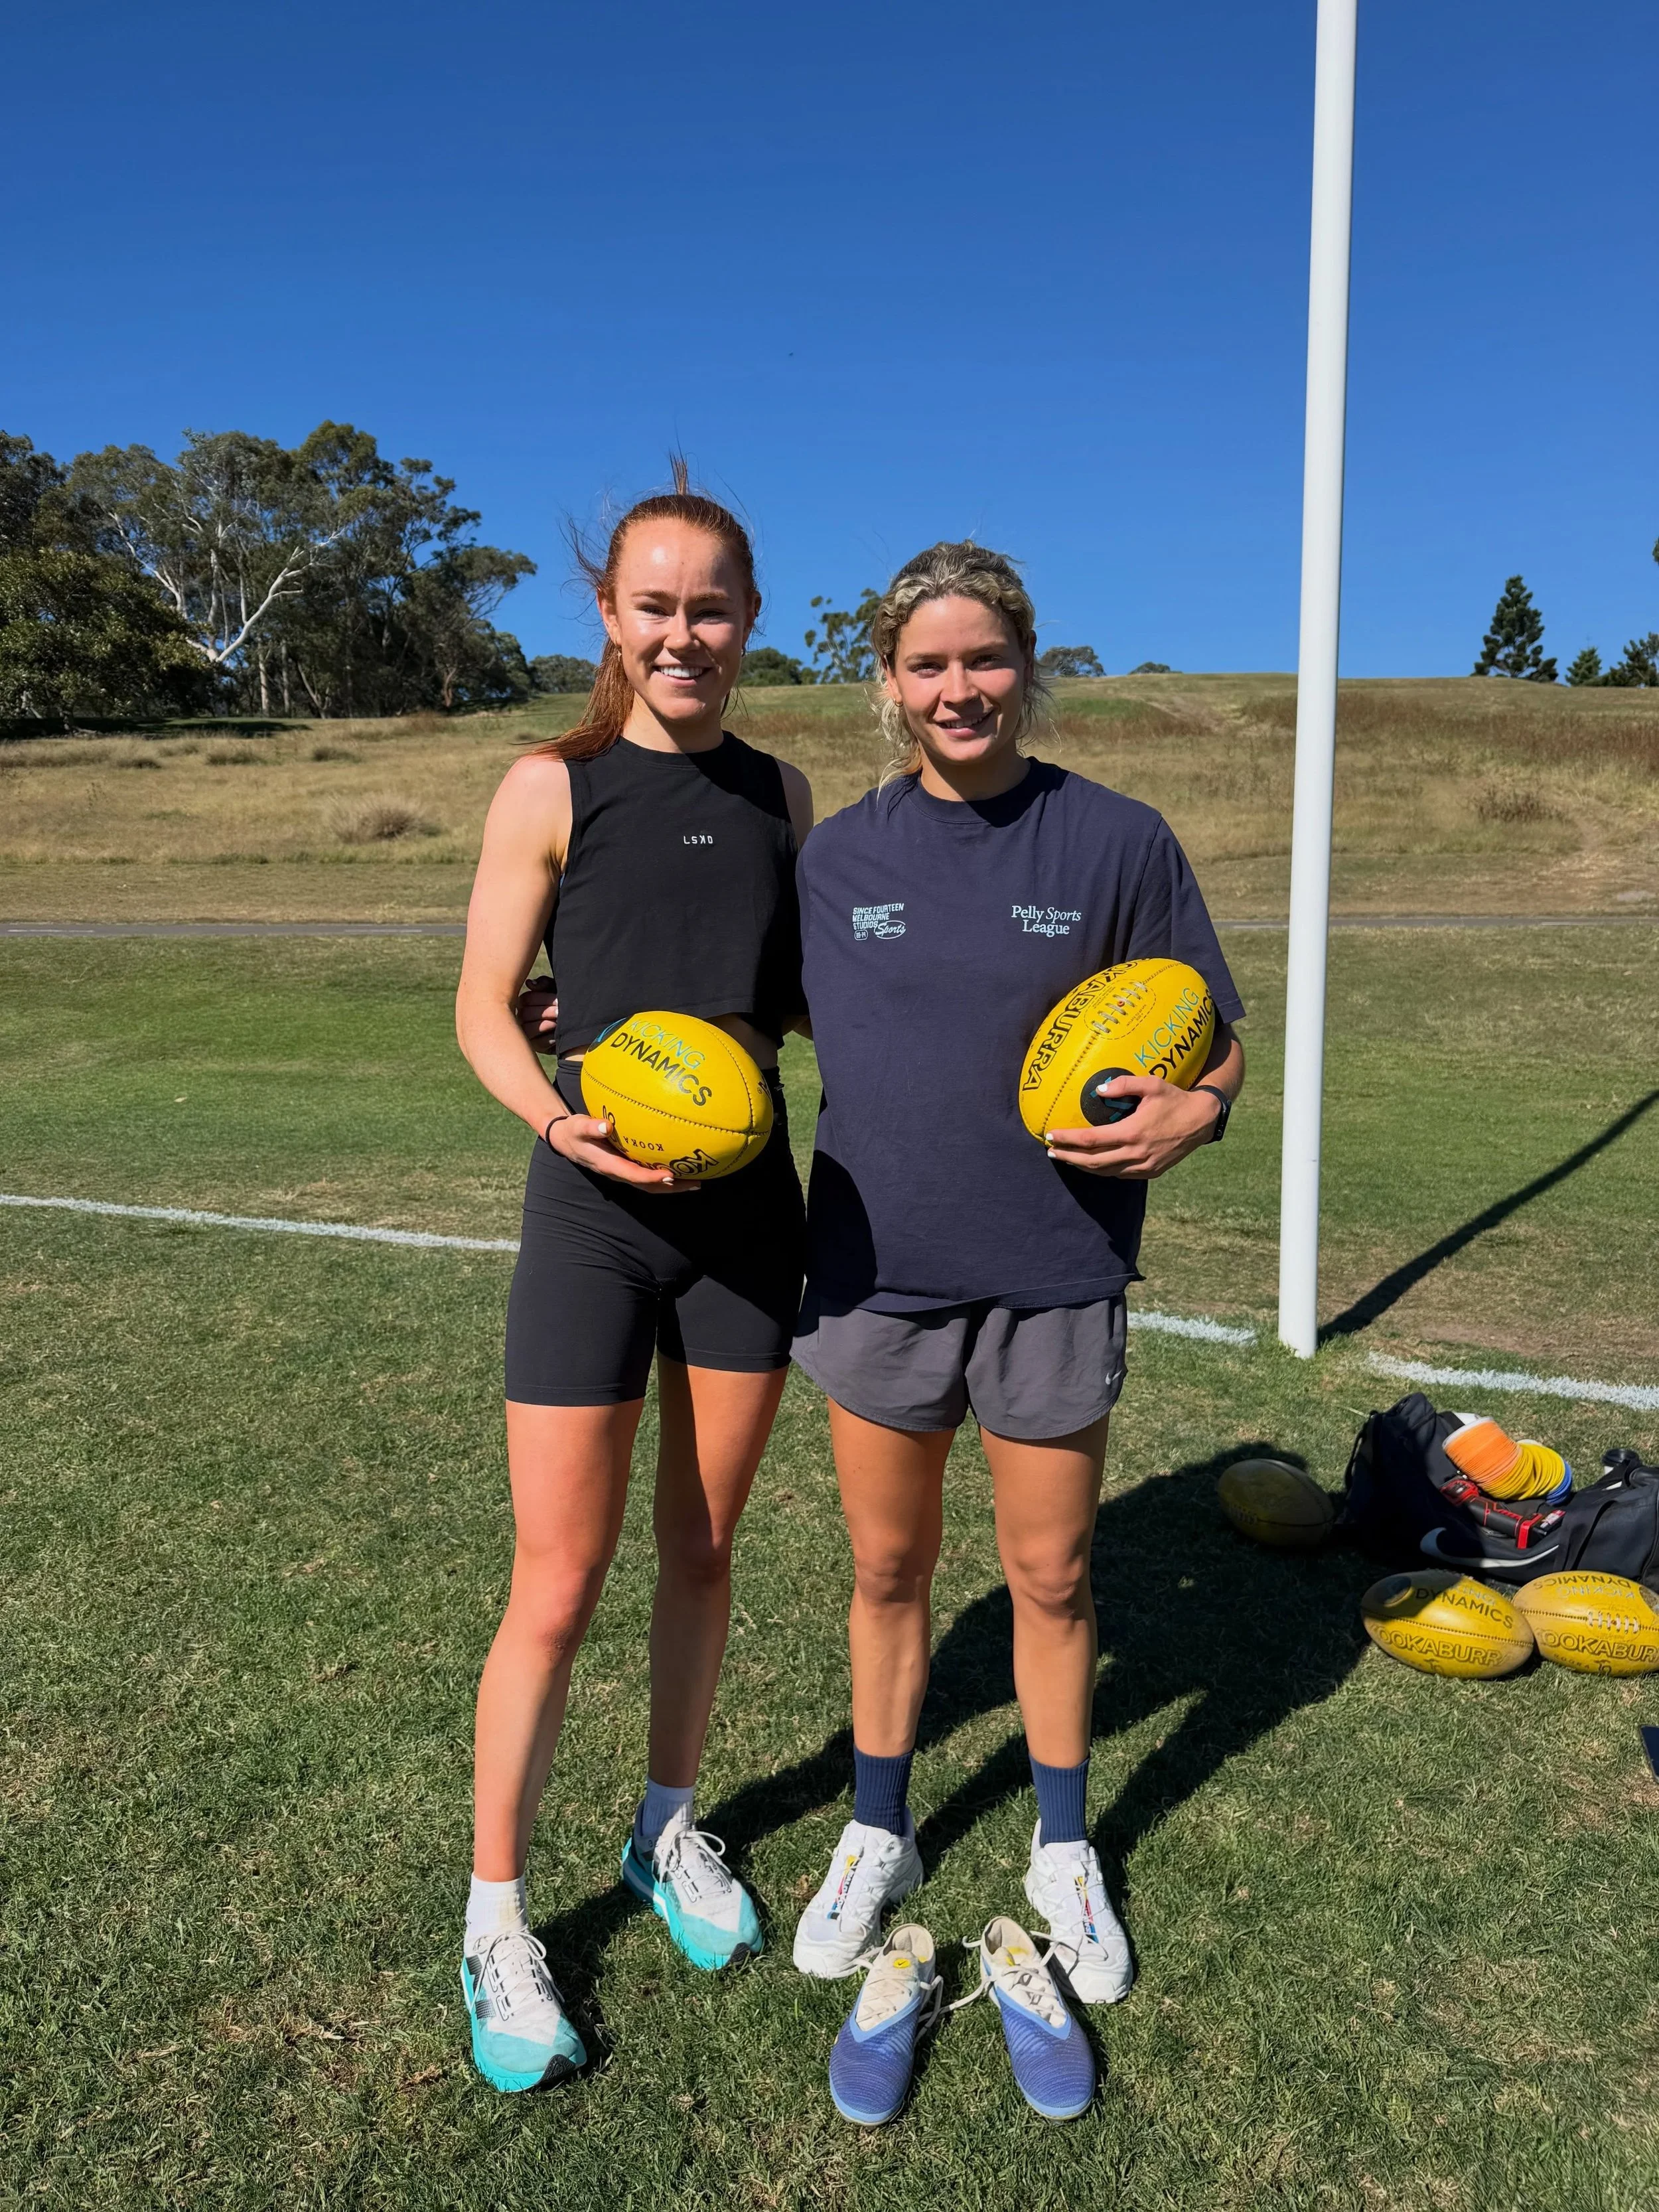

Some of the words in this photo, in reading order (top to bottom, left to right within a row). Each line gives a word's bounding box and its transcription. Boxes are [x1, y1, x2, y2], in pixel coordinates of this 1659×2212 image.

[683, 835, 713, 844] LSKD
[873, 903, 904, 913] FOURTEEN
[1011, 905, 1045, 923] Pelly
[1045, 907, 1082, 924] Sports
[852, 913, 890, 922] MELBOURNE
[853, 921, 878, 930] STUDIOS
[875, 922, 906, 937] Sports
[1022, 919, 1070, 937] League
[1133, 988, 1200, 1069] KICKING
[627, 1019, 705, 1070] KICKING
[610, 1031, 713, 1106] DYNAMICS
[622, 1136, 664, 1152] KOOKA
[1534, 1575, 1631, 1590] DYNAMICS
[1415, 1587, 1514, 1630] DYNAMICS
